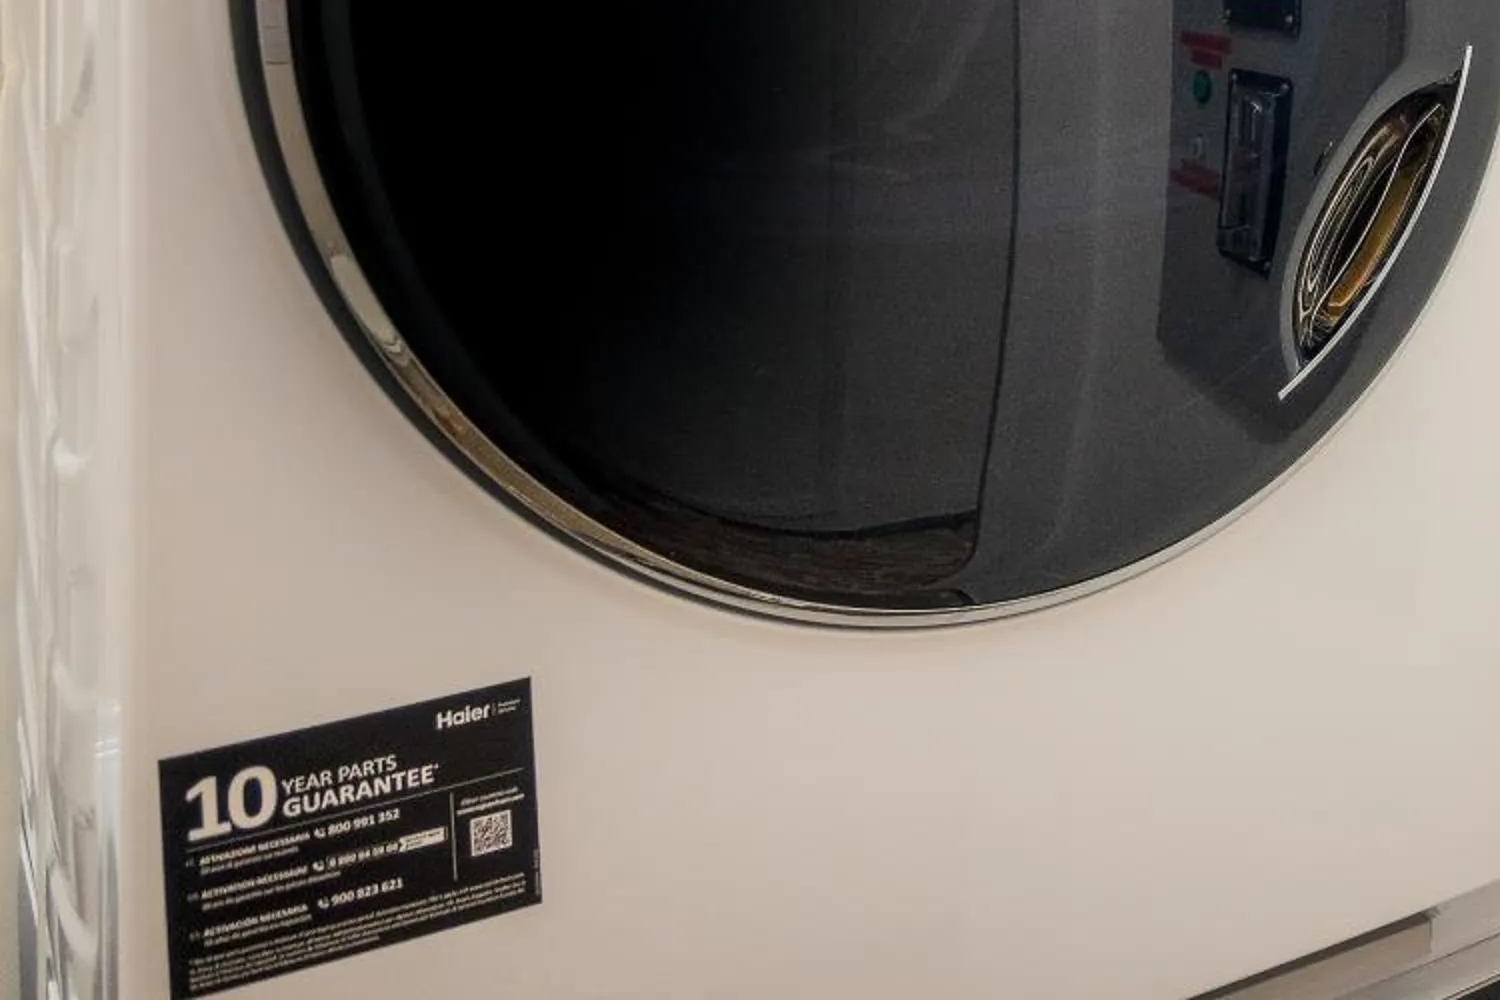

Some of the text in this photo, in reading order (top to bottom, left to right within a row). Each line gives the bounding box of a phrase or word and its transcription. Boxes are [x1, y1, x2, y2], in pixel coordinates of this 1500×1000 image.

[436, 704, 490, 729] Haier
[281, 755, 398, 797] YEAR PARTS
[185, 764, 278, 843] 10
[328, 821, 351, 836] 800
[377, 808, 400, 824] 352
